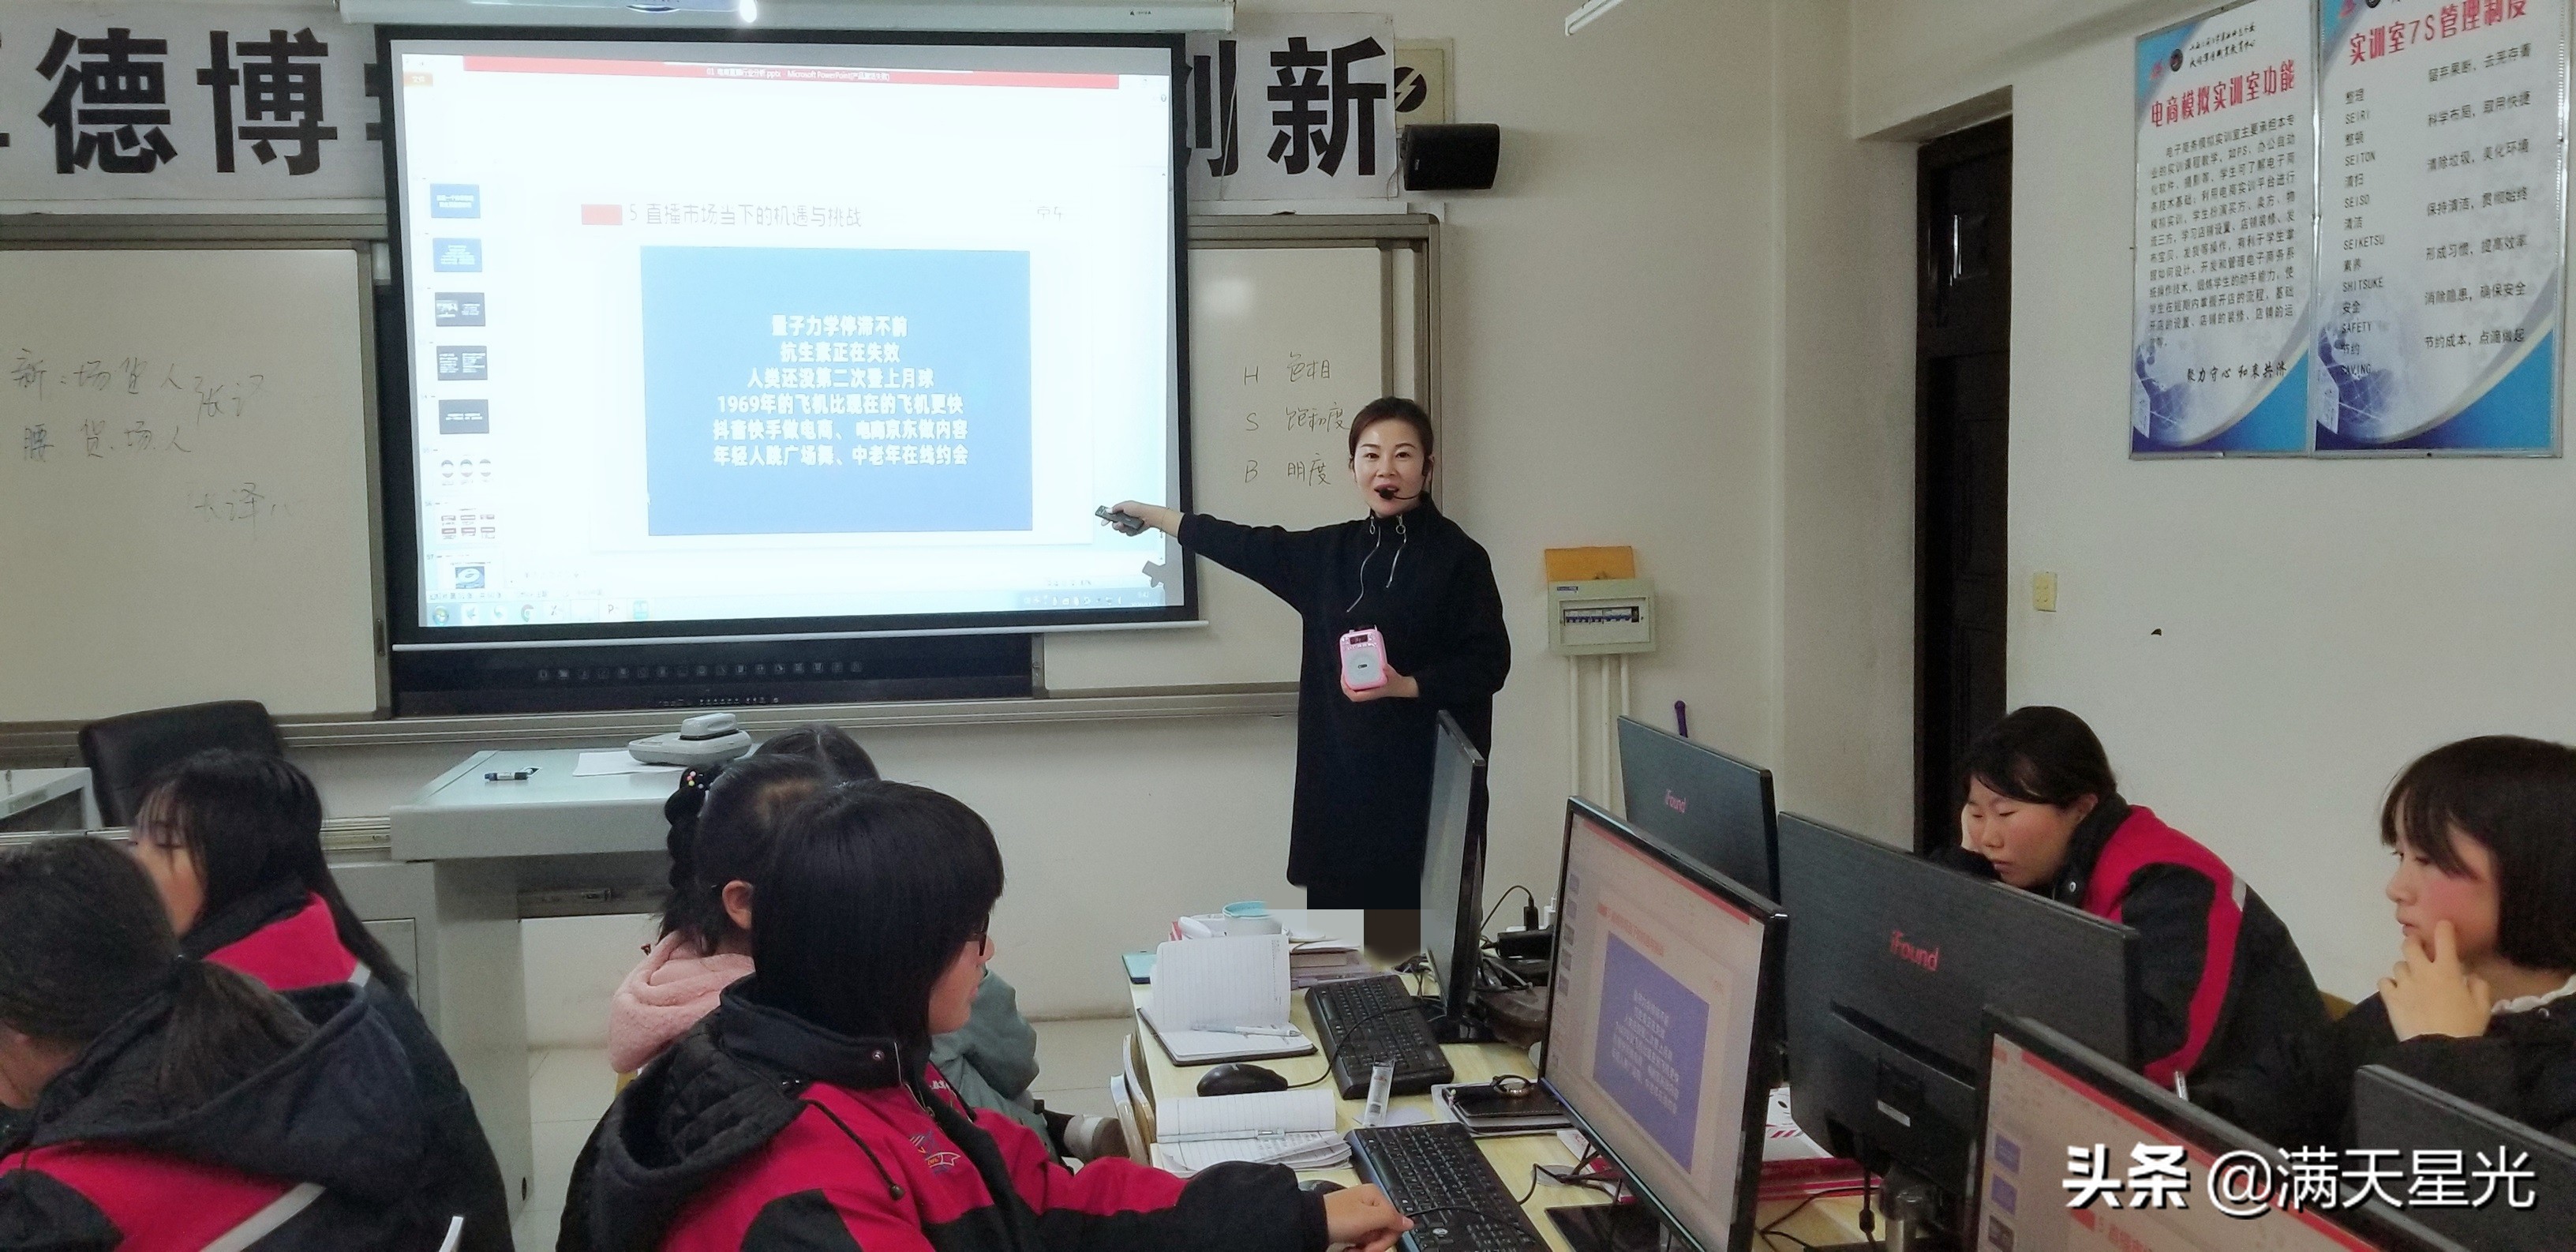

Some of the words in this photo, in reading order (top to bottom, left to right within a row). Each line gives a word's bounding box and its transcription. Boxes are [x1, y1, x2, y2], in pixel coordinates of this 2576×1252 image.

[0, 28, 383, 176] 德博
[2151, 59, 2294, 127] 电商模拟实训室功能
[2344, 194, 2370, 209] SEISO
[630, 204, 637, 221] 5
[646, 203, 862, 227] 直播市场当下的机遇与挑战
[2343, 234, 2385, 251] SEIKETSU
[2342, 276, 2383, 293] SHITSUKE
[2424, 281, 2526, 306] 消除隐患，确保安全
[2342, 300, 2361, 315] 安全
[771, 314, 908, 338] 量子力学停滞不前
[2342, 321, 2372, 334] SAFETY
[780, 342, 901, 363] 抗生素正在失效
[747, 367, 935, 389] 人类还没第二次登上月球
[1244, 365, 1259, 386] H
[1286, 351, 1331, 383] 色相
[717, 393, 964, 415] 1969年的飞机比现在的飞机更快
[1245, 413, 1260, 432] S
[1286, 402, 1351, 433] 饱和度
[713, 419, 969, 441] 抖音快手做电商、电商京东做内容
[713, 444, 969, 467] 年轻人跳广场舞、中老年在线约会
[1245, 460, 1259, 483] B
[1287, 452, 1331, 486] 明度
